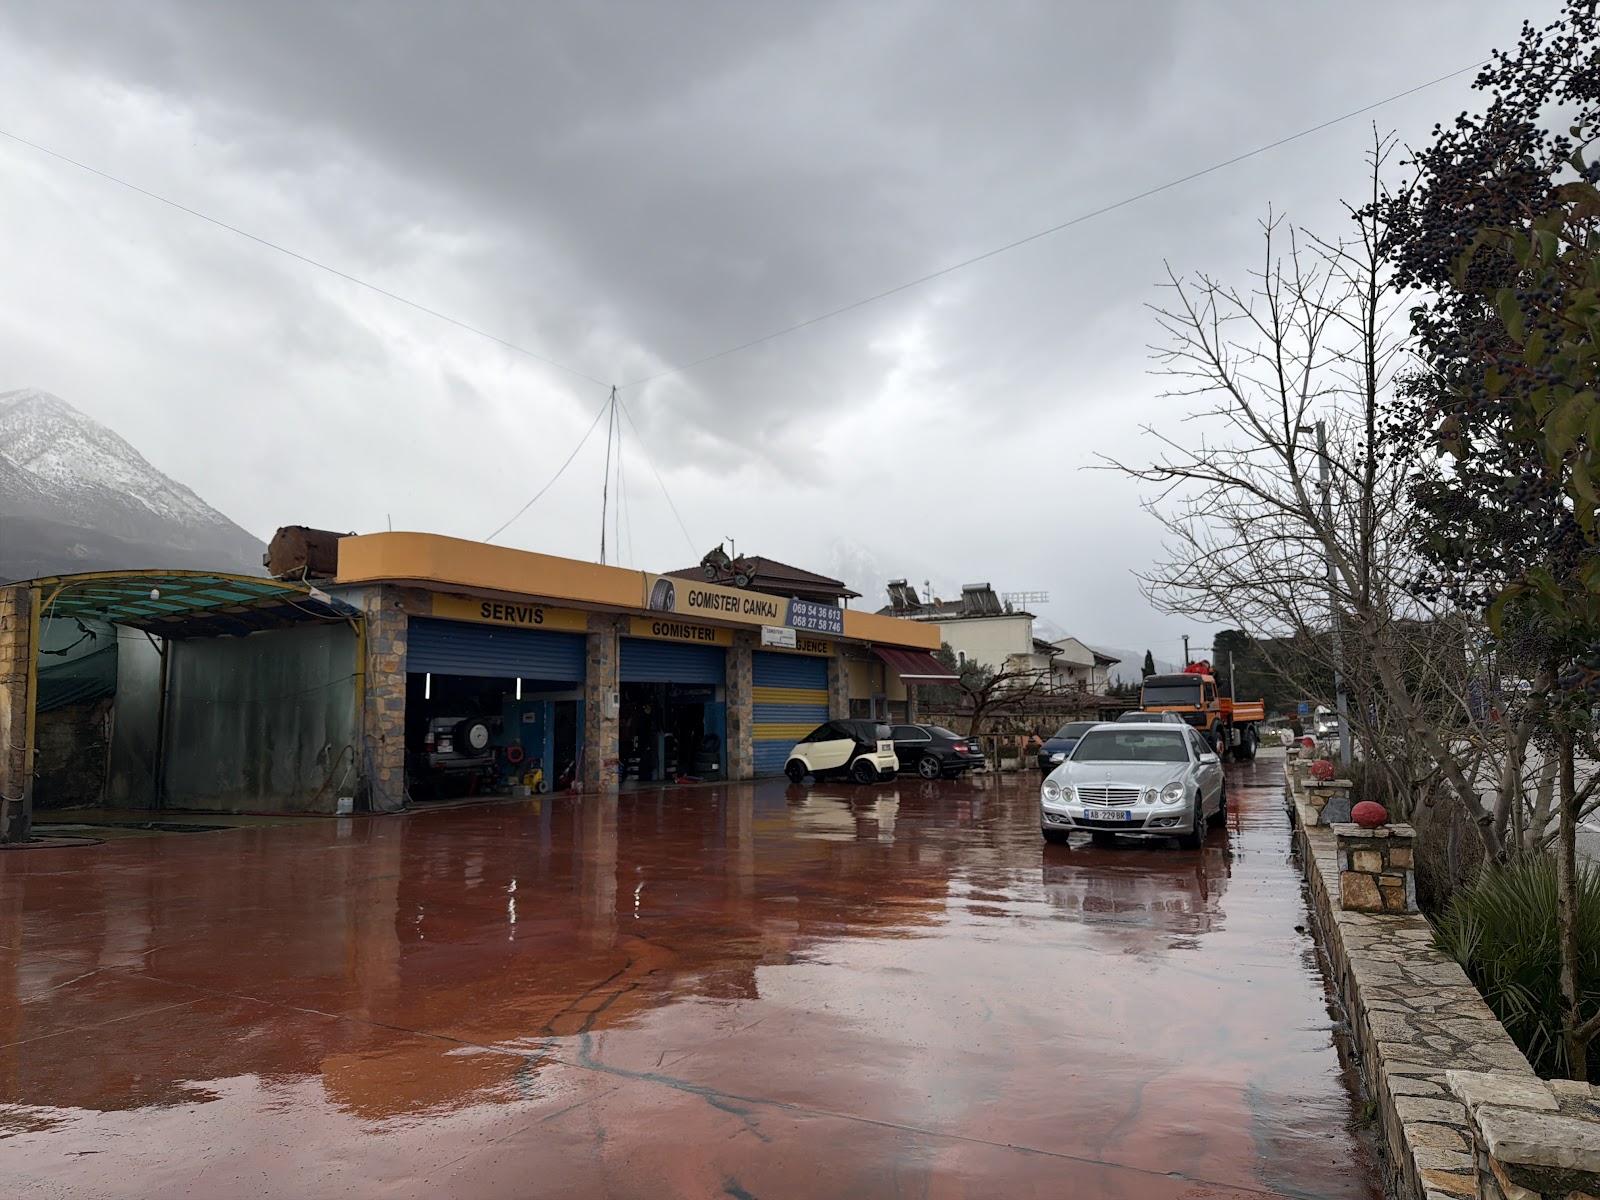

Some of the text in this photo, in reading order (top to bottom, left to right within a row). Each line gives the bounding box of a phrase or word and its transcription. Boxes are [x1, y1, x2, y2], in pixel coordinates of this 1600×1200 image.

[688, 590, 778, 618] GOMISTERI CANKAJ
[792, 603, 841, 620] 069 54 36 613
[481, 602, 544, 624] SERVIS
[652, 622, 715, 641] GOMISTERI
[792, 616, 841, 632] 068 27 58 746
[796, 640, 828, 653] GJENCE
[1091, 811, 1125, 820] AB 229 BR
